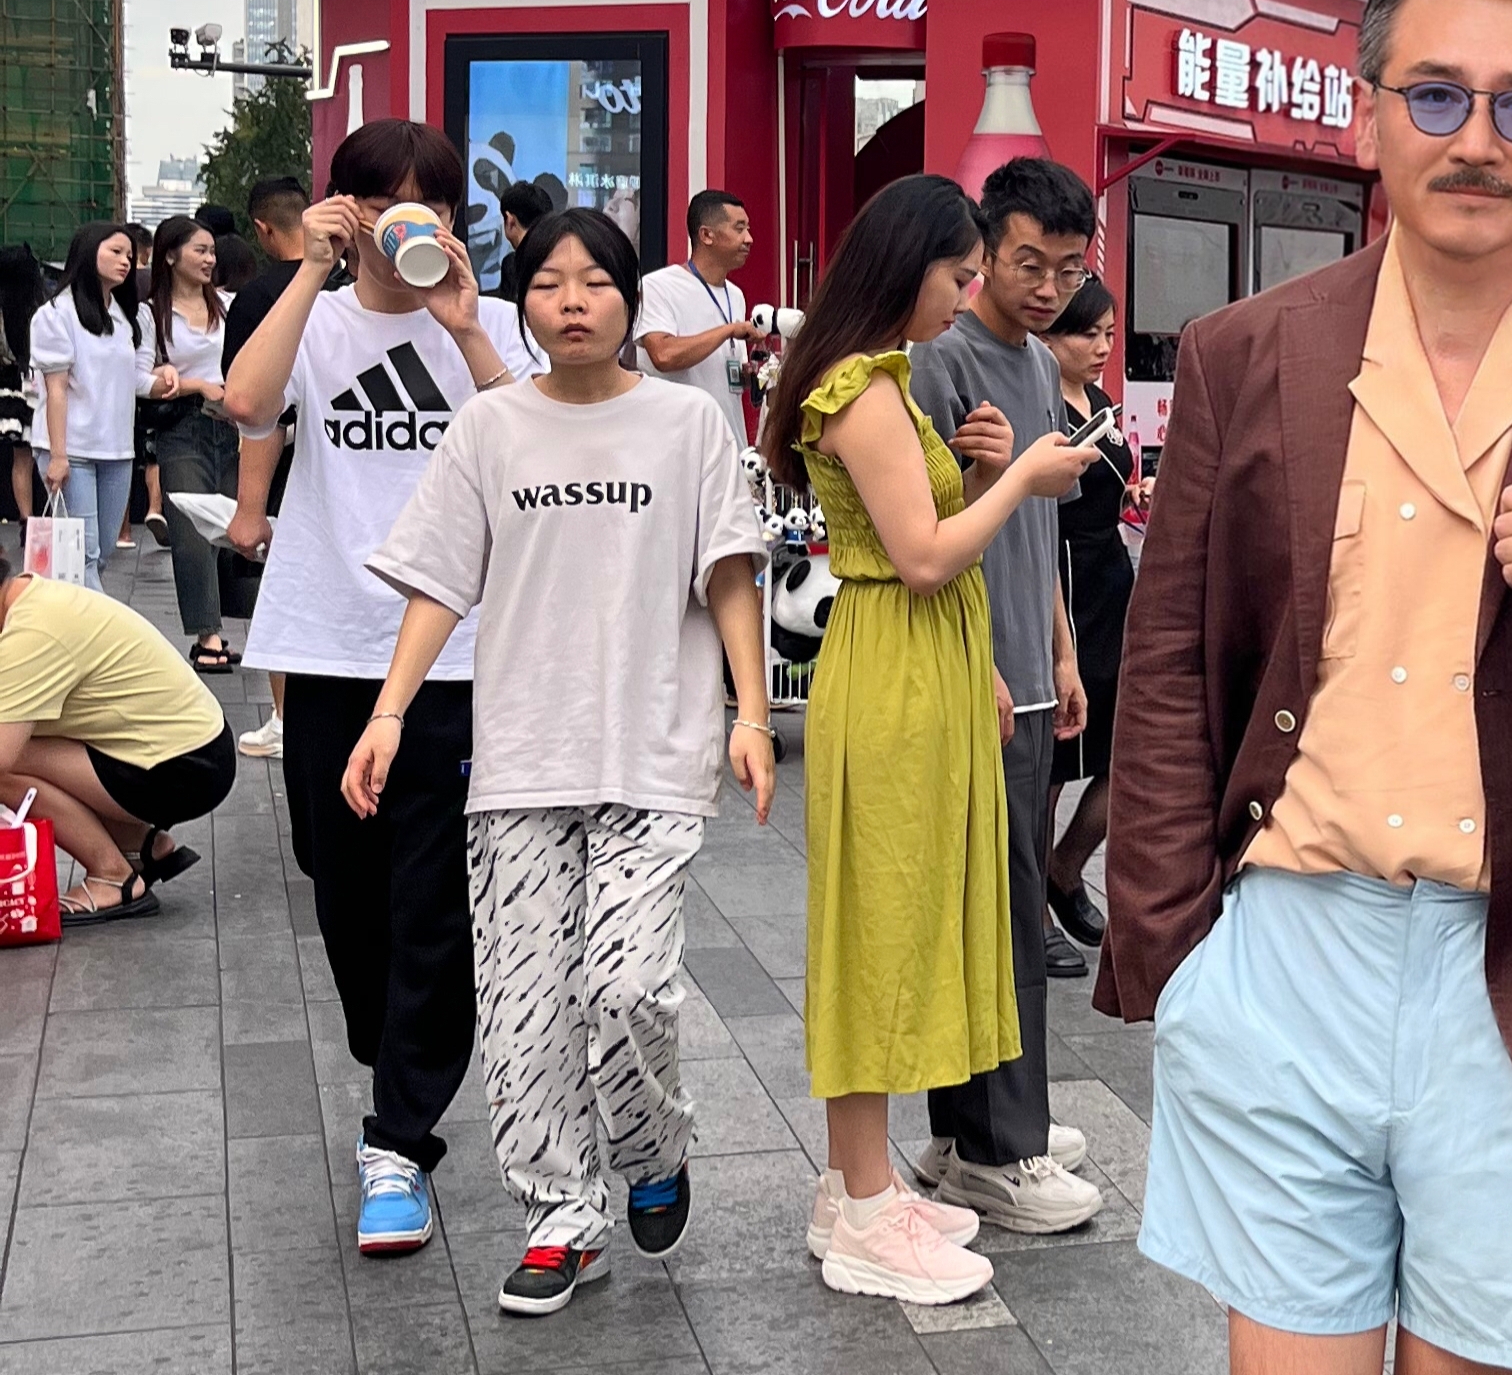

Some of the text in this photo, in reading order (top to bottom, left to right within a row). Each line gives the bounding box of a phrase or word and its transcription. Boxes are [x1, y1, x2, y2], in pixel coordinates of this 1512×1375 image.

[1178, 27, 1354, 129] 能量补给站
[324, 410, 450, 451] adida
[511, 481, 653, 514] wassup
